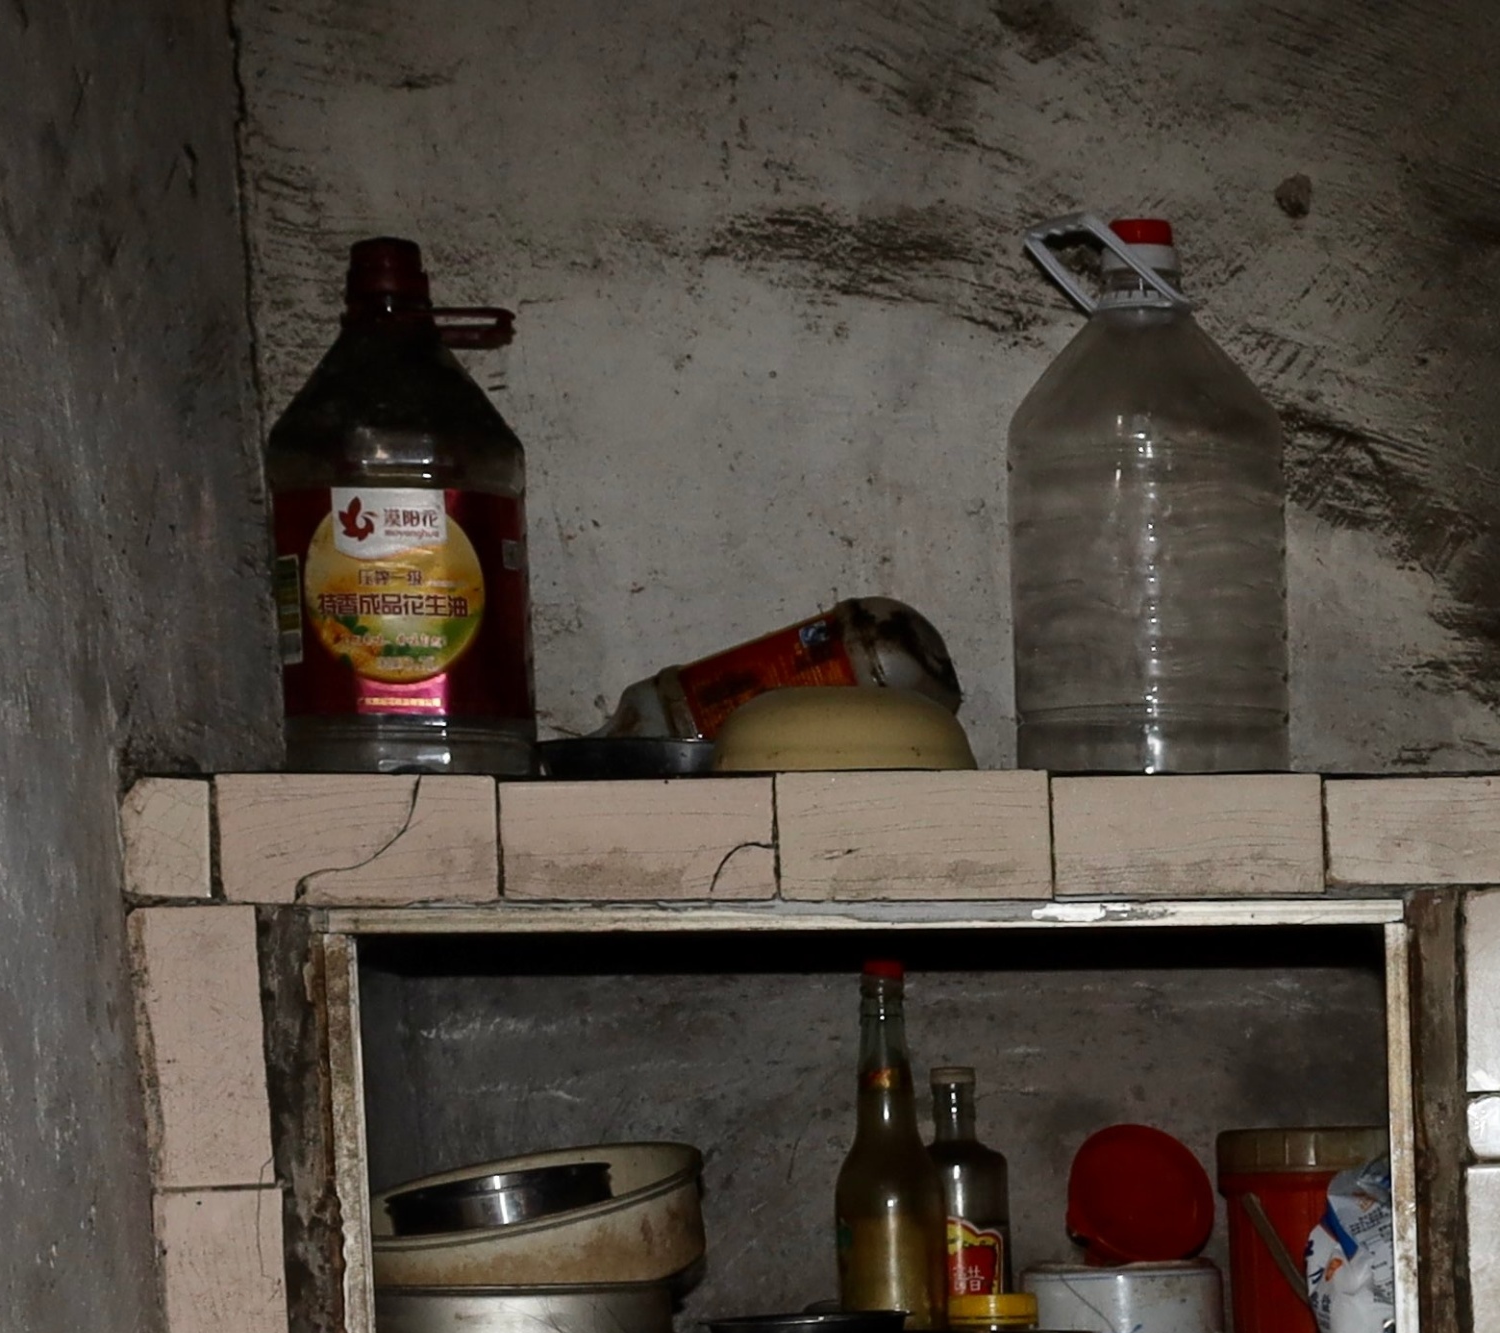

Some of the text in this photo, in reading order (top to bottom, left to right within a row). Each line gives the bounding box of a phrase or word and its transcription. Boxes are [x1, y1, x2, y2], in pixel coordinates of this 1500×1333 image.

[317, 592, 469, 618] 特香成品花生油
